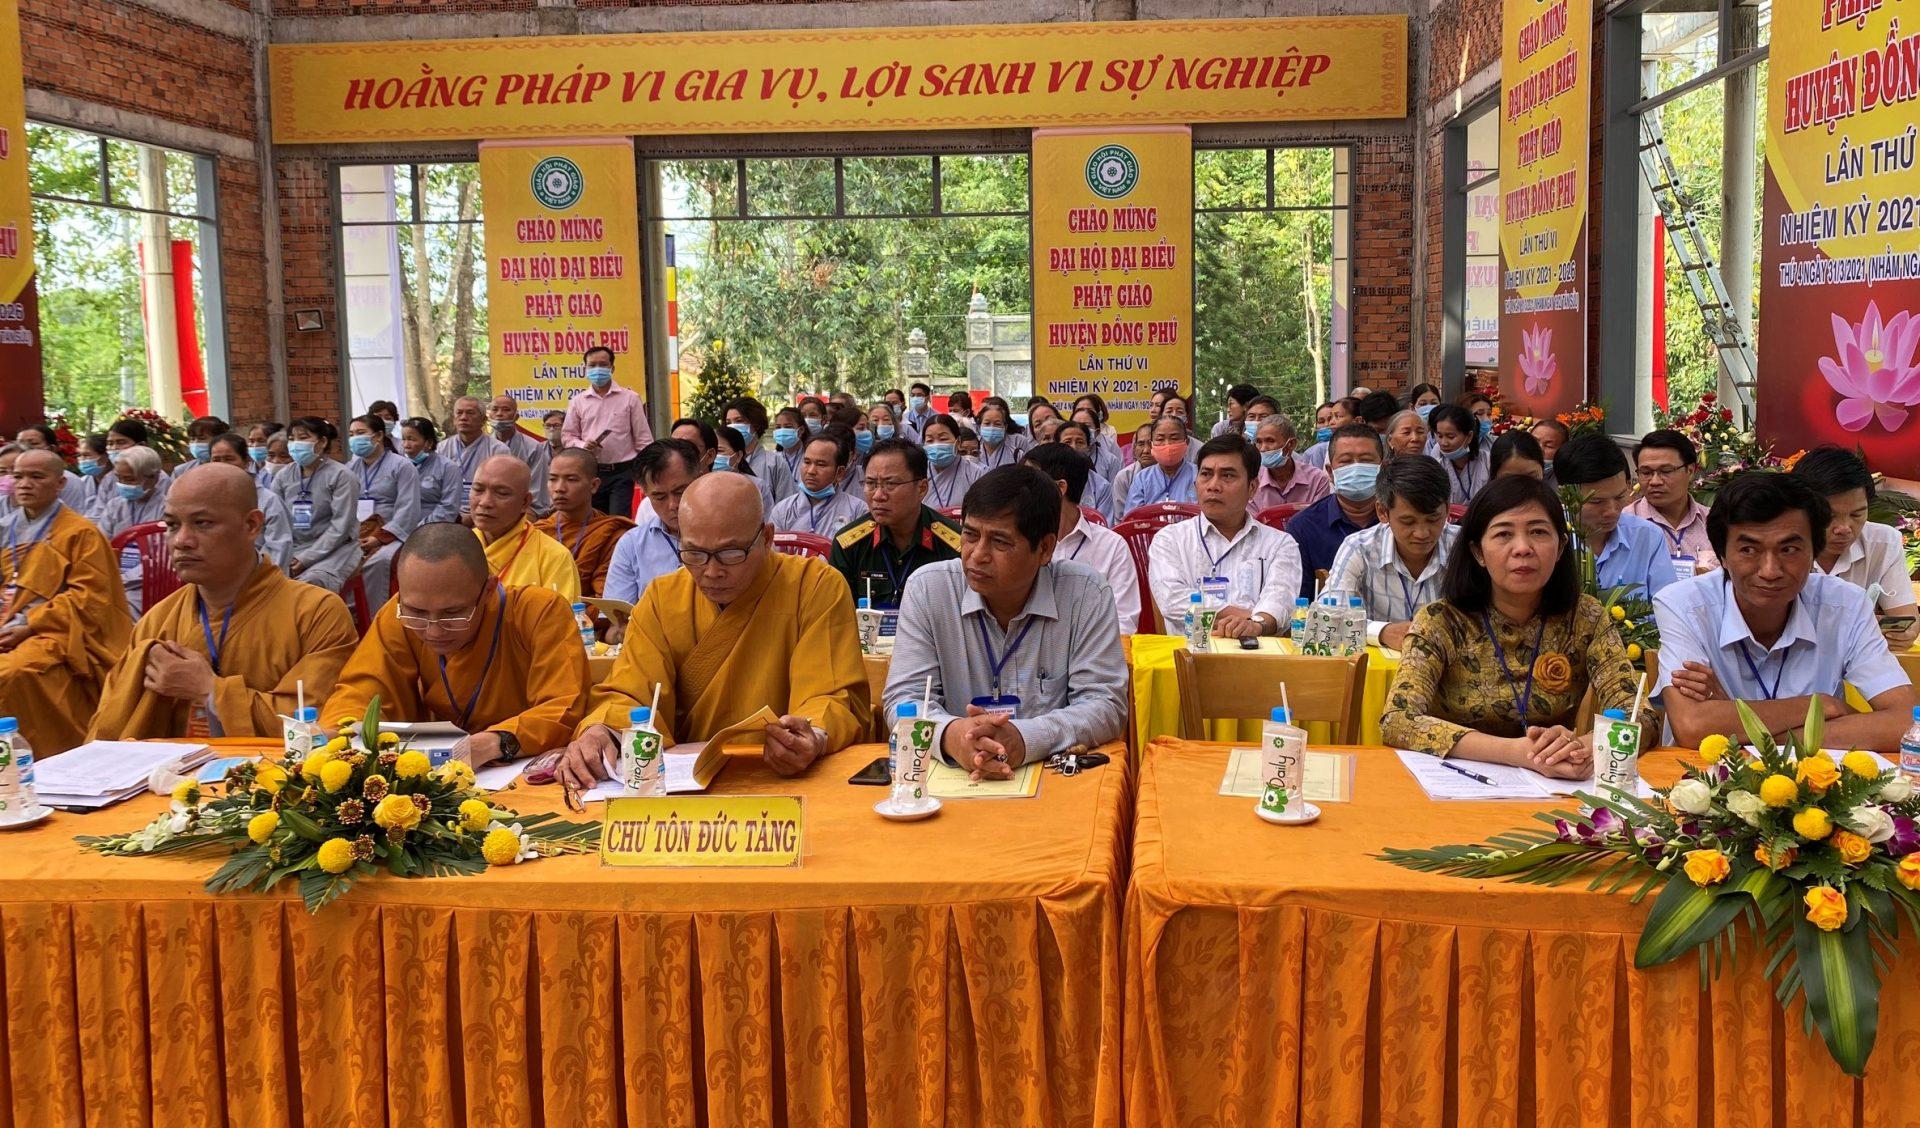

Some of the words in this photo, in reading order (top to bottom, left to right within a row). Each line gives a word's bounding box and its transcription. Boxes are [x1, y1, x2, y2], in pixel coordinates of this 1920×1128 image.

[343, 62, 488, 110] HOẰNG
[495, 64, 610, 105] PHÁP
[621, 71, 664, 102] VI
[675, 69, 749, 101] GIA
[760, 67, 827, 109] VỤ,
[839, 62, 911, 107] LỢI
[919, 61, 1037, 97] SANH
[1046, 61, 1094, 93] VI
[1100, 56, 1165, 101] SỰ
[1165, 46, 1331, 98] NGHIỆP
[1784, 50, 1858, 135] HUYỆN
[1861, 17, 1920, 113] ĐỒN
[1825, 136, 1864, 184] LẦN
[1871, 125, 1917, 174] THỨ
[516, 214, 557, 243] CHÀO
[1068, 203, 1109, 233] CHÀO
[1780, 202, 1837, 249] NHIỆM
[1844, 194, 1872, 237] KỲ
[1049, 247, 1077, 275] ĐẠI
[1079, 241, 1108, 275] HỘI
[1111, 246, 1138, 275] ĐẠI
[1140, 236, 1176, 270] BIỂU
[1550, 231, 1558, 249] VI
[500, 256, 527, 286] ĐẠI
[530, 252, 558, 285] HỘI
[560, 255, 586, 285] ĐẠI
[589, 246, 624, 280] BIỂU
[1537, 265, 1552, 284] 2021
[1558, 261, 1576, 282] 2026
[1827, 257, 1866, 284] 31/3/2021
[524, 289, 563, 323] PHẬT
[567, 288, 604, 318] GIÁO
[1073, 280, 1113, 314] PHẬT
[1117, 279, 1153, 308] GIÁO
[502, 327, 551, 360] HUYỆN
[553, 322, 596, 355] ĐỒNG
[1048, 318, 1098, 351] HUYỆN
[1101, 314, 1144, 347] ĐỒNG
[1148, 317, 1179, 346] PHÚ
[1079, 353, 1104, 371] LẦN
[1107, 354, 1134, 370] THỨ
[1135, 357, 1149, 370] VI
[547, 384, 564, 401] KỲ
[1048, 377, 1089, 396] NHIỆM
[1092, 377, 1109, 393] KỲ
[1112, 380, 1139, 393] 2021
[904, 748, 928, 782] Daily
[1268, 754, 1296, 788] Daily
[1600, 750, 1629, 784] Daily
[607, 815, 651, 853] CHƯ
[654, 811, 693, 853] TÔN
[696, 810, 738, 853] ĐỨC
[745, 810, 797, 853] TĂNG
